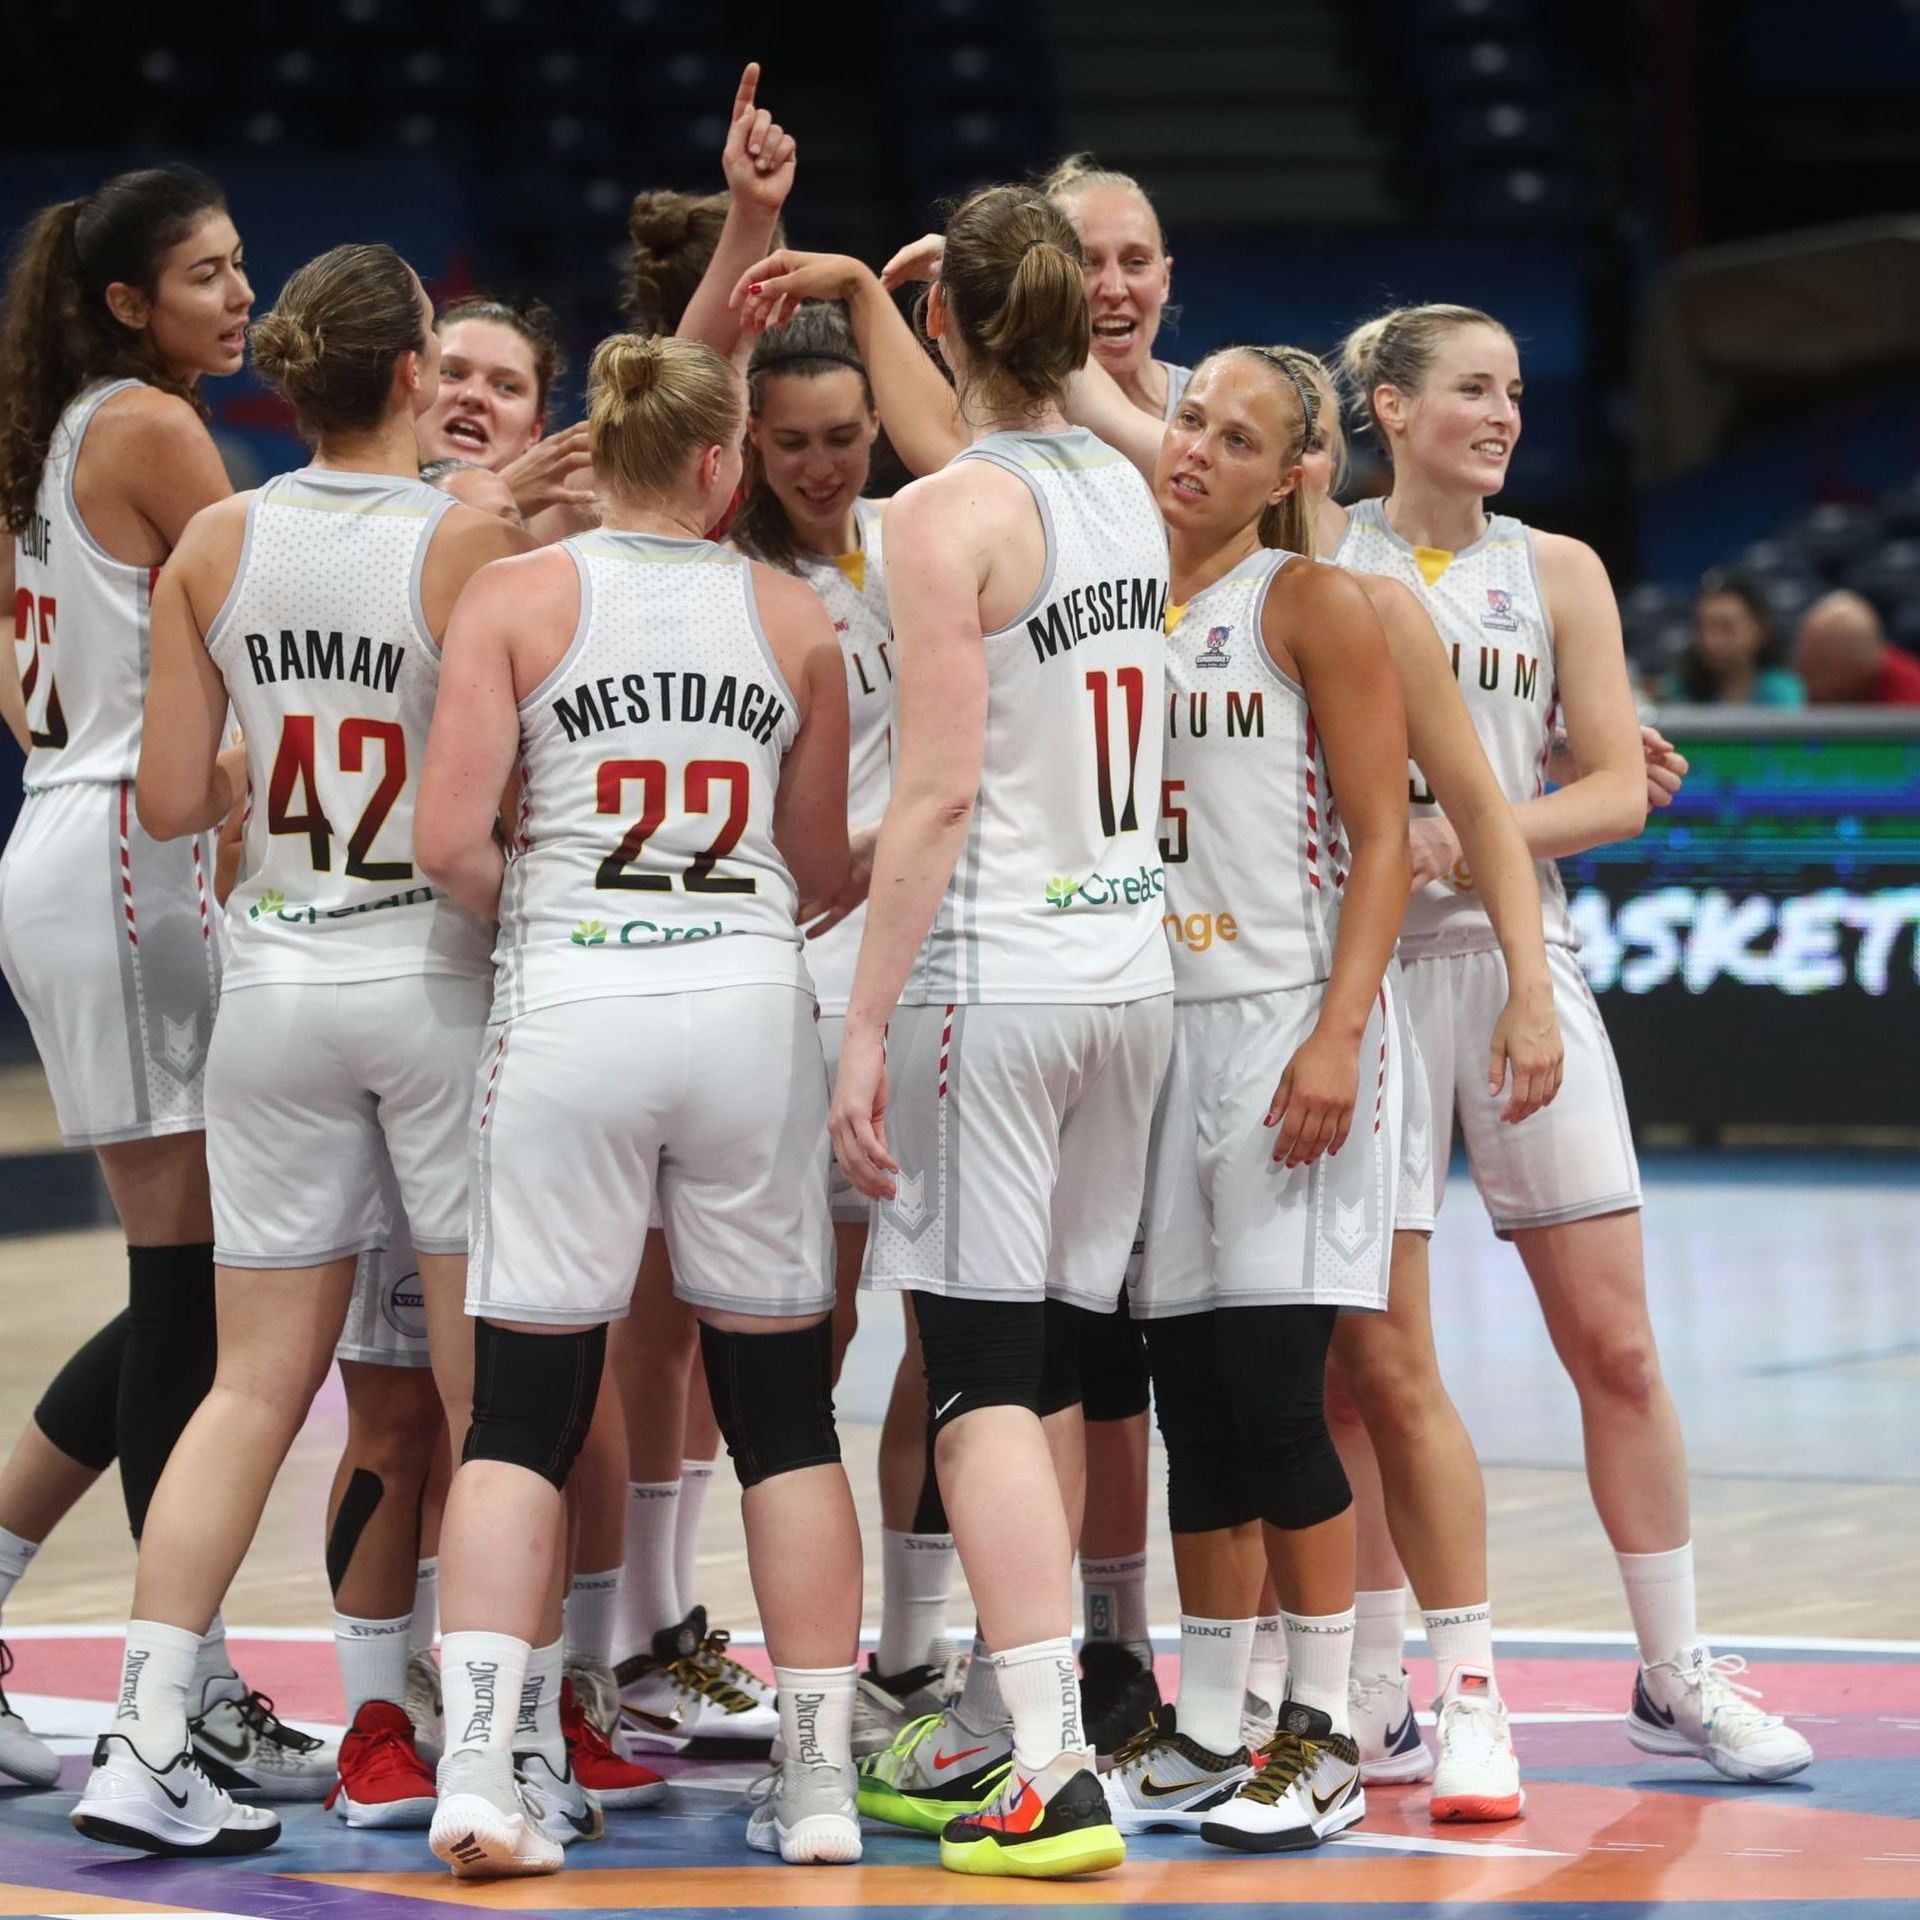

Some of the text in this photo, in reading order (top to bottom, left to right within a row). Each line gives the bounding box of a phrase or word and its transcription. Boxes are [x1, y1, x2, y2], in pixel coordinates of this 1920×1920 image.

[244, 629, 406, 694] RAMAN
[551, 671, 786, 746] MESTDAGH
[1085, 666, 1144, 838] 11
[268, 714, 414, 882] 42
[594, 759, 757, 895] 22
[1158, 779, 1189, 863] 5
[1162, 911, 1239, 953] nge
[1569, 886, 1920, 996] ASKET
[1181, 1624, 1232, 1639] LDING
[116, 1650, 150, 1722] SPALDING
[462, 1661, 499, 1744] SPALDING
